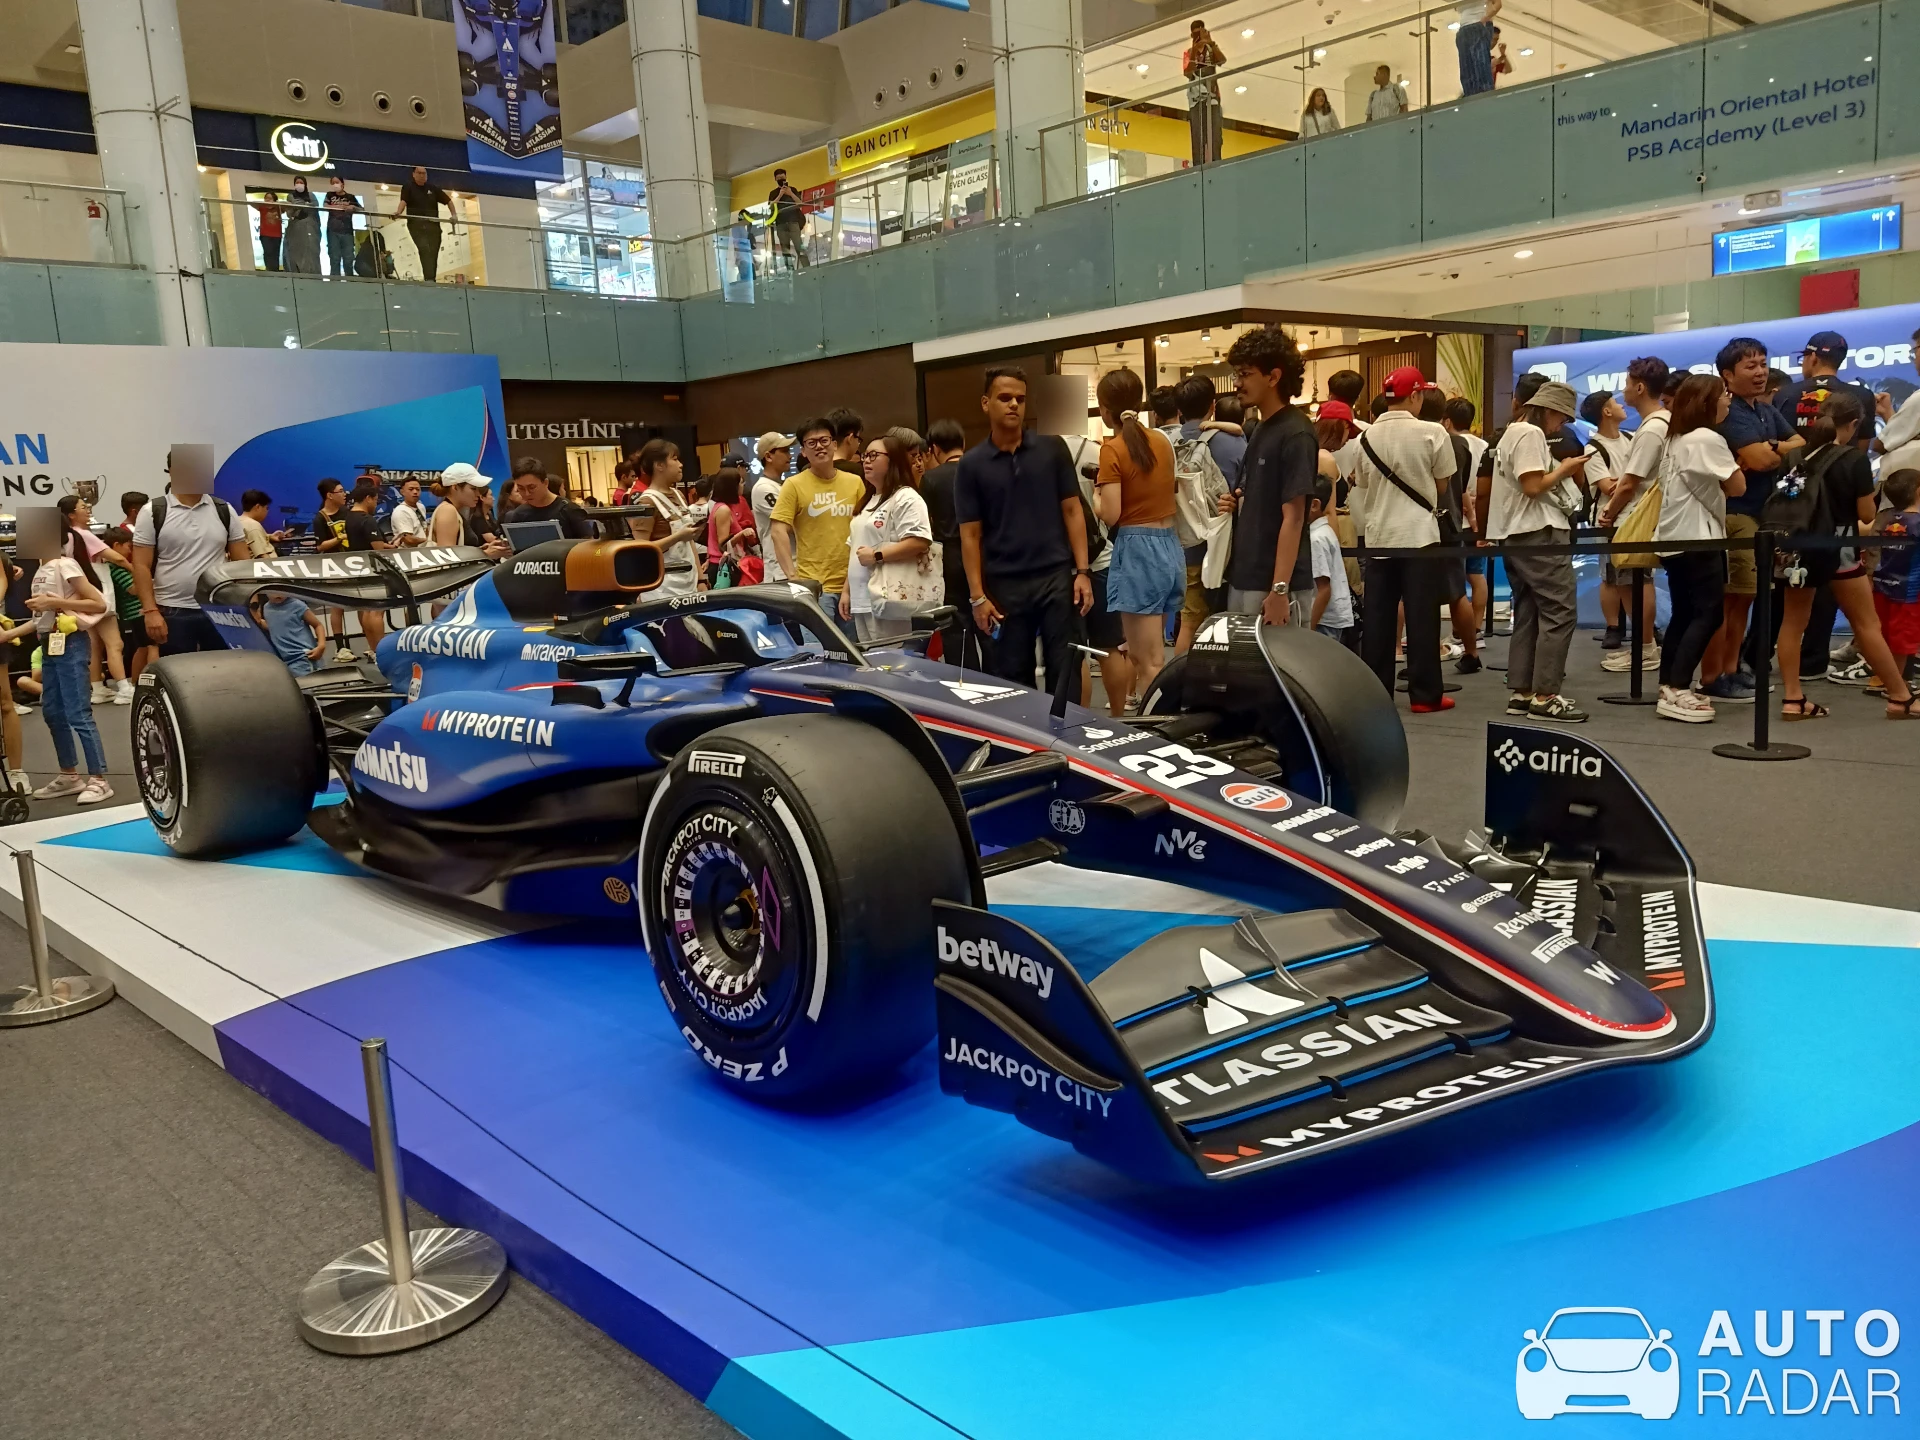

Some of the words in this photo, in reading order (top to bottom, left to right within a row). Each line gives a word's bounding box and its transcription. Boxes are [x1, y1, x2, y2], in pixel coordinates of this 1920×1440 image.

[1557, 114, 1576, 127] this
[1577, 110, 1598, 125] way
[1600, 106, 1611, 118] to
[1621, 105, 1715, 137] Mandarin
[1720, 83, 1807, 116] Oriental
[1813, 68, 1876, 97] Hotel
[470, 115, 508, 146] ATLASSIAN
[525, 125, 556, 150] ATLASSIAN
[845, 138, 876, 159] GAIN
[880, 126, 910, 148] CITY
[1627, 142, 1663, 162] PSB
[1669, 123, 1767, 152] Academy
[1772, 104, 1838, 135] (Level
[1845, 99, 1867, 119] 3)
[967, 172, 988, 184] GLASS
[852, 234, 874, 245] logitech
[1796, 402, 1820, 413] Red
[380, 470, 442, 480] ATLASSIA
[812, 491, 837, 506] JUST
[830, 503, 846, 517] DO
[513, 560, 561, 576] DURACELL
[681, 593, 708, 608] airia
[608, 611, 630, 624] KEEPER
[396, 623, 497, 661] ATLASSIAN
[531, 642, 576, 664] kraken
[1191, 643, 1230, 652] ATLASSIAN
[438, 709, 556, 747] MYPROTEIN
[1078, 730, 1154, 754] Santander
[688, 750, 747, 778] PIRELLI
[1118, 743, 1236, 790] 23
[1528, 745, 1603, 778] airia
[1232, 787, 1280, 807] Gulf
[663, 818, 701, 887] JACKPOT
[702, 813, 739, 839] CITY
[1344, 836, 1396, 858] betway
[1440, 871, 1472, 888] VAST
[1472, 890, 1506, 909] KEEPER
[1641, 889, 1683, 971] MYPROTEIN
[937, 925, 1055, 999] betway
[1530, 931, 1580, 965] PIRELLI
[709, 986, 769, 1022] JACKPOT
[681, 1025, 765, 1082] ZERO
[771, 1046, 789, 1077] P
[1152, 1003, 1462, 1111] TLASSIAN
[944, 1037, 1051, 1094] JACKPOT
[1055, 1074, 1113, 1118] CITY
[1260, 1055, 1585, 1149] MYPROTEIN
